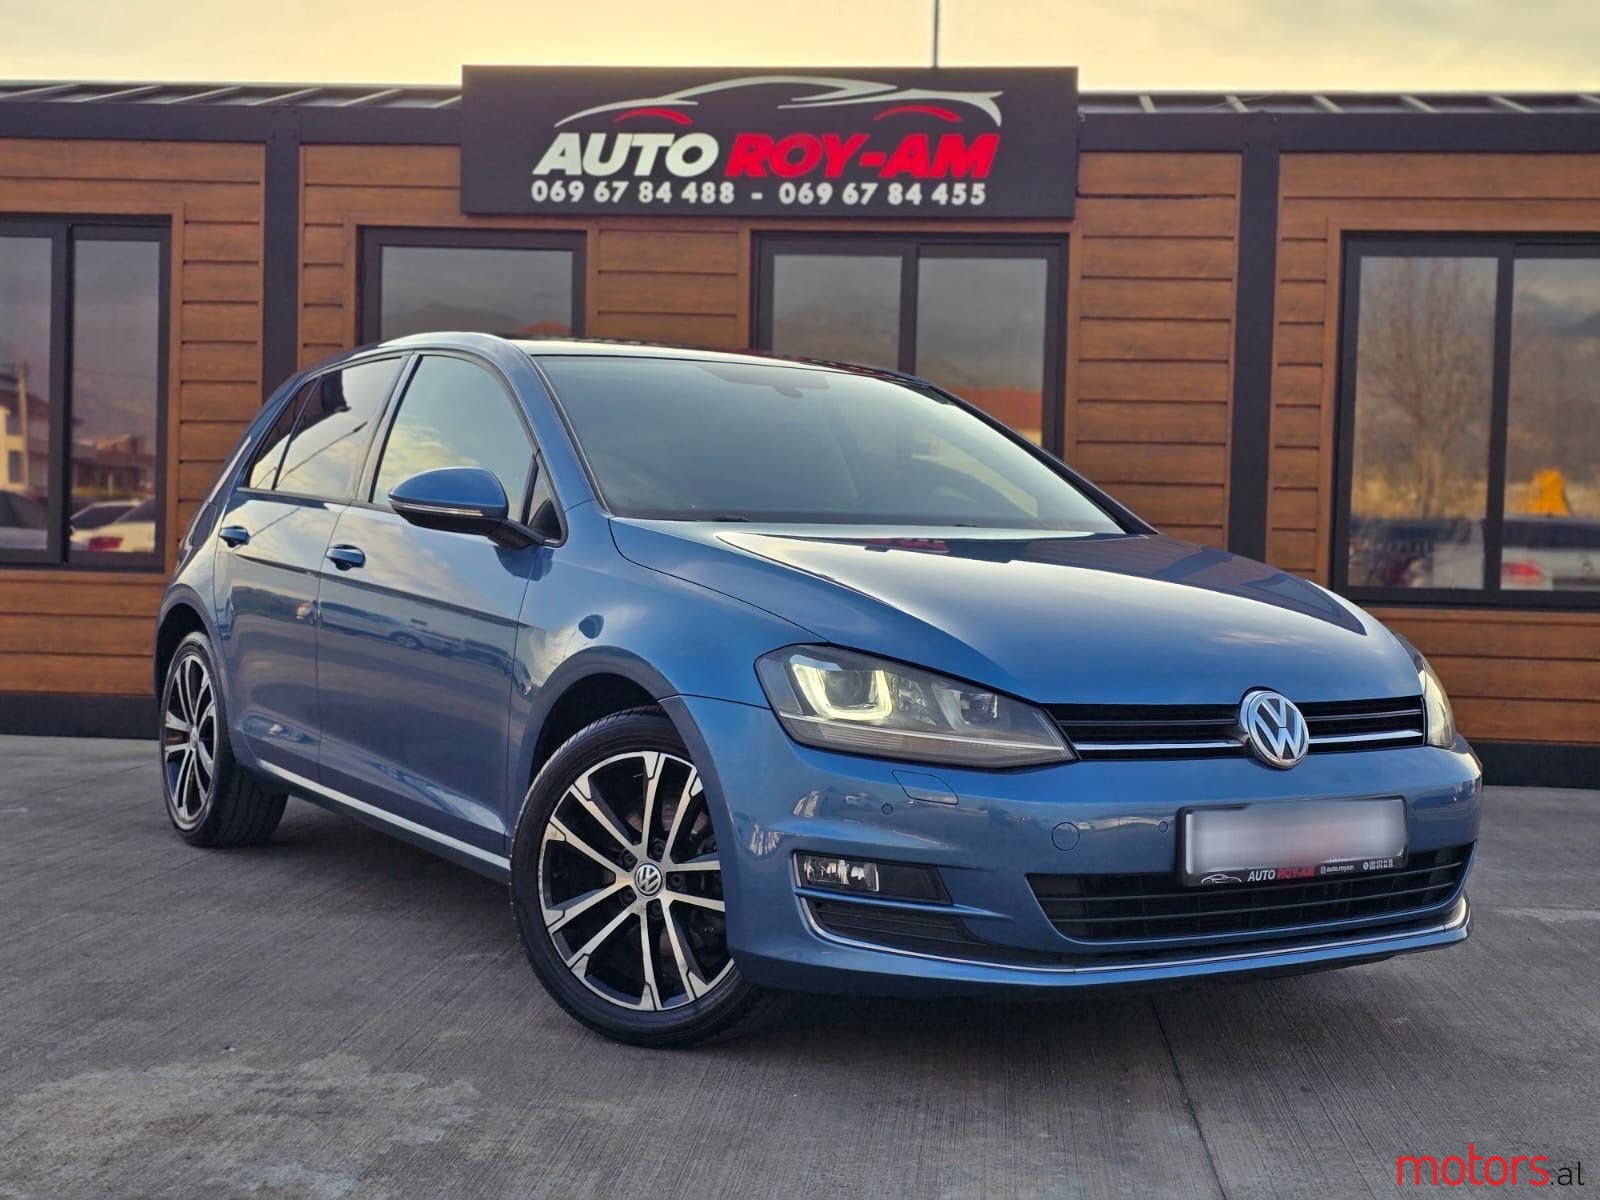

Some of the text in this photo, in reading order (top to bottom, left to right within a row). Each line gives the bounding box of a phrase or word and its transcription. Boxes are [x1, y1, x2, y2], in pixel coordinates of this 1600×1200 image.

[532, 132, 1000, 178] AUTO ROY-AM
[531, 180, 585, 203] 069
[593, 181, 629, 203] 67
[638, 181, 672, 203] 84
[681, 181, 734, 204] 488
[778, 182, 833, 205] 069
[842, 182, 878, 205] 67
[888, 182, 922, 205] 84
[931, 182, 986, 205] 455
[1247, 869, 1276, 882] AUTO
